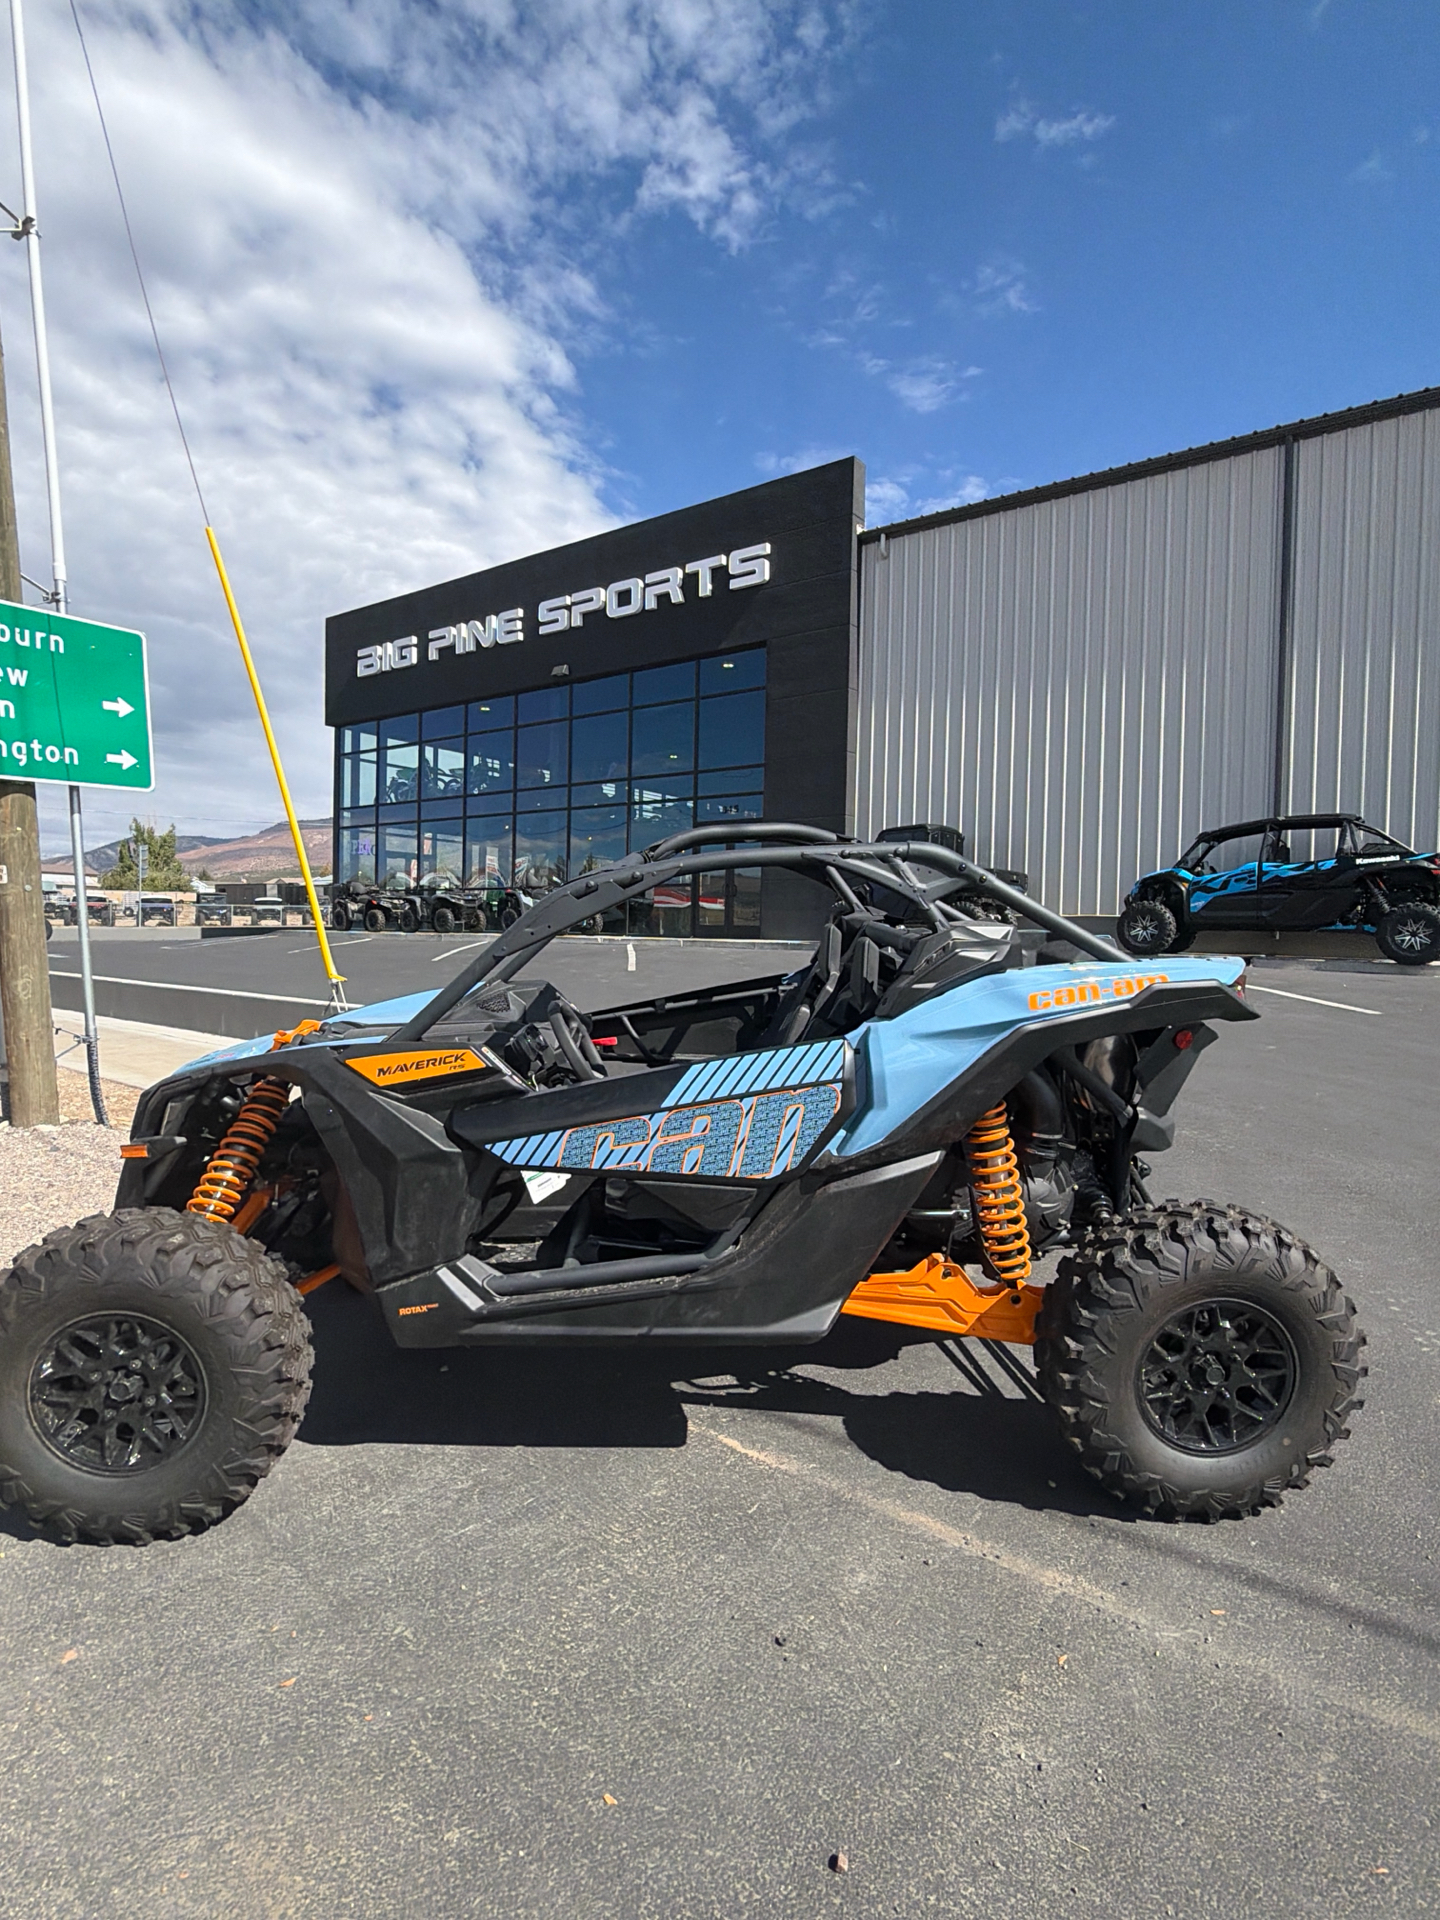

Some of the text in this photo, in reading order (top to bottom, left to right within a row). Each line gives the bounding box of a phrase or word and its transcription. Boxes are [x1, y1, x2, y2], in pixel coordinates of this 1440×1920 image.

[356, 542, 771, 678] BIG PINE SPORTS
[377, 1053, 467, 1077] MAVERICK
[557, 1084, 842, 1179] can
[399, 1305, 428, 1316] ROTAX
